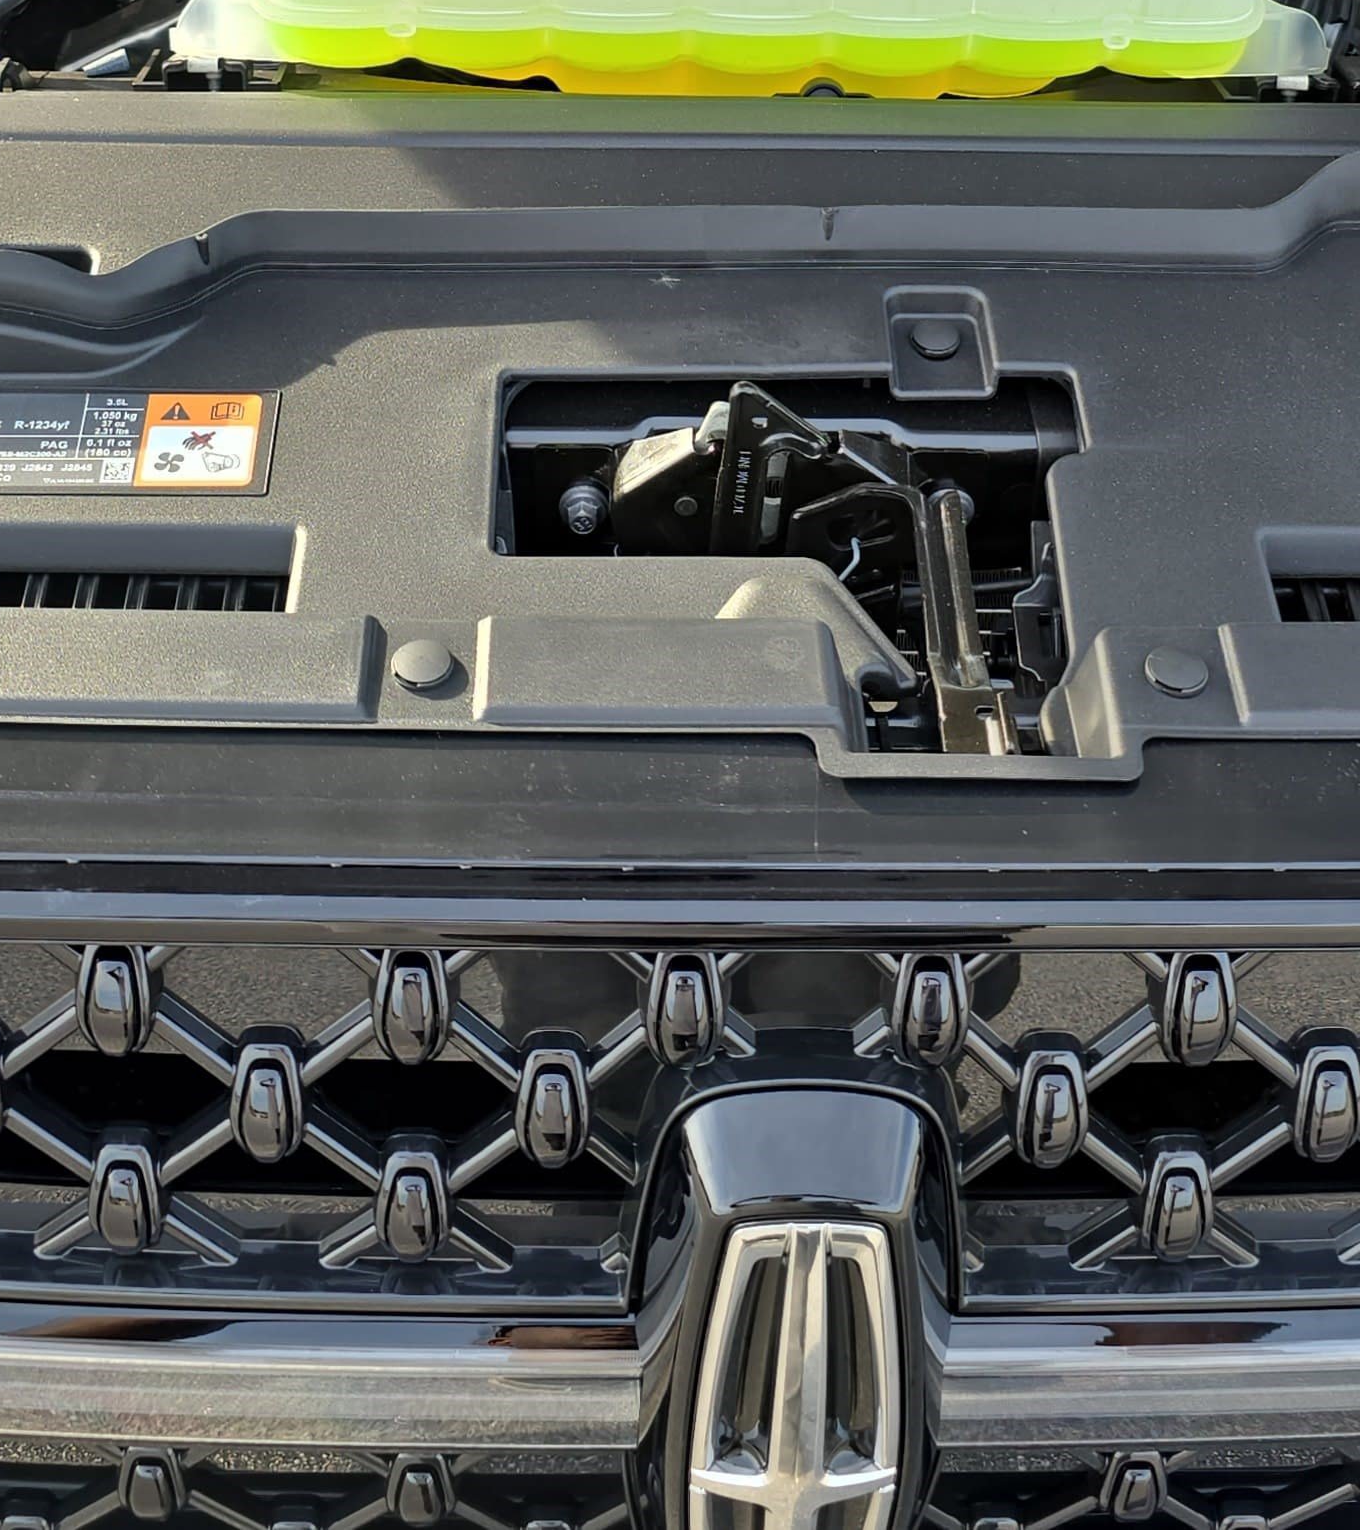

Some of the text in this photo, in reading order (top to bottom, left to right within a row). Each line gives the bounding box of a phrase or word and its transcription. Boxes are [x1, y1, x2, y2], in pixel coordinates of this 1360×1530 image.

[93, 411, 138, 422] 1.050 kg
[14, 420, 71, 432] R-1234yf
[40, 440, 68, 450] PAG
[118, 439, 133, 448] oz
